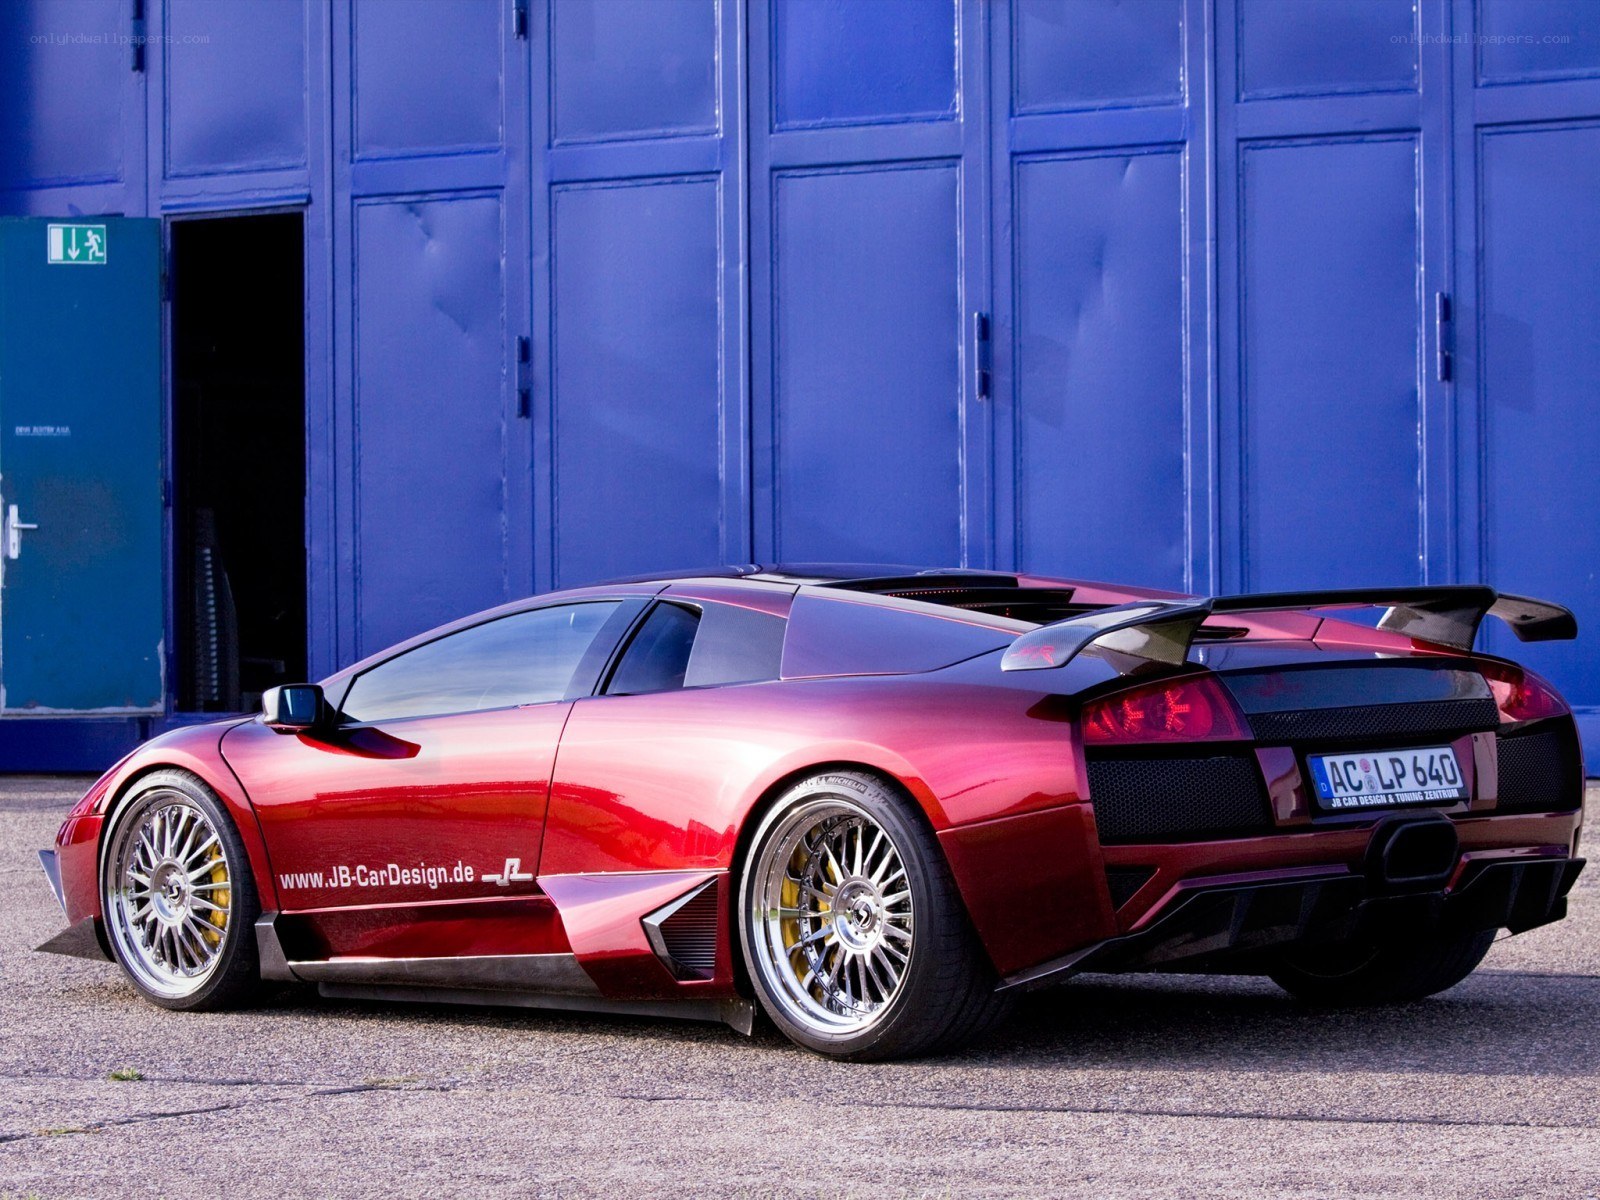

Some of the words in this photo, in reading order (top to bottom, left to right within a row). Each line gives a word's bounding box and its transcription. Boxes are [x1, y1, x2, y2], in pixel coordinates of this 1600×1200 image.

[1329, 760, 1363, 793] AC
[1373, 757, 1406, 790] LP
[1413, 754, 1458, 787] 640
[827, 777, 867, 793] MICHELIN
[1320, 782, 1327, 792] D
[1331, 798, 1342, 808] JB
[1342, 796, 1359, 807] CAR
[1360, 793, 1387, 805] DESIGN
[1388, 793, 1395, 803] &
[1395, 791, 1424, 802] TUNING
[1424, 788, 1460, 800] ZENTRUM
[280, 860, 475, 889] www.JB-CarDesign.de
